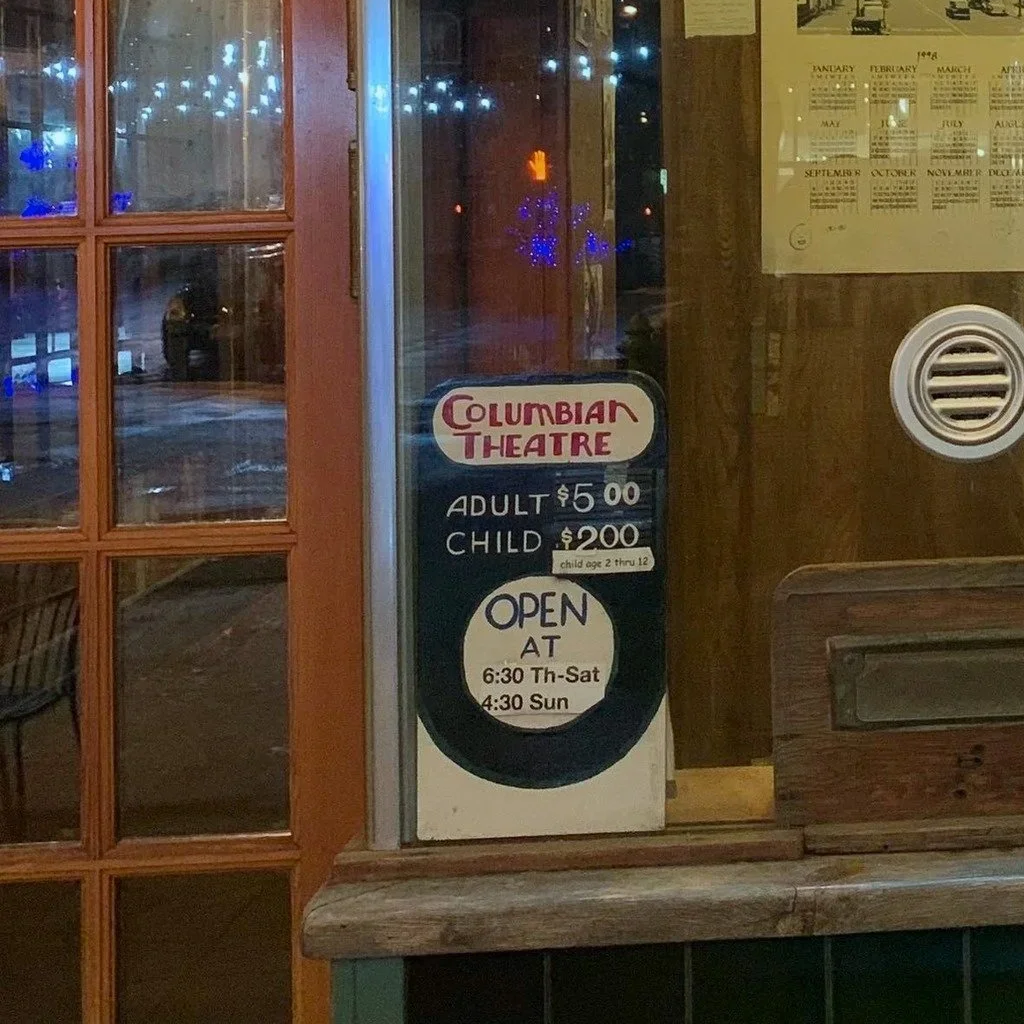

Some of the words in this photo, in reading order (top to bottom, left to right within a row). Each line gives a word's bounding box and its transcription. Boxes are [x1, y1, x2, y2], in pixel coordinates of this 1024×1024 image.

[812, 65, 855, 73] JANUARY
[870, 65, 918, 73] FEBRUARY
[937, 66, 971, 74] MARCH
[821, 120, 840, 128] MAY
[942, 120, 963, 128] JULY
[452, 432, 612, 459] THEATRE
[446, 494, 550, 517] ADULT
[446, 531, 542, 555] CHILD
[560, 558, 583, 569] child
[586, 560, 602, 572] age
[605, 558, 612, 567] 2
[614, 558, 635, 567] thru
[638, 556, 648, 566] 12
[485, 592, 588, 629] OPEN
[521, 635, 561, 659] AT
[483, 668, 524, 684] 6:30
[530, 667, 600, 683] Th-Sat
[482, 695, 523, 710] 4:30
[529, 695, 569, 710] Sun
